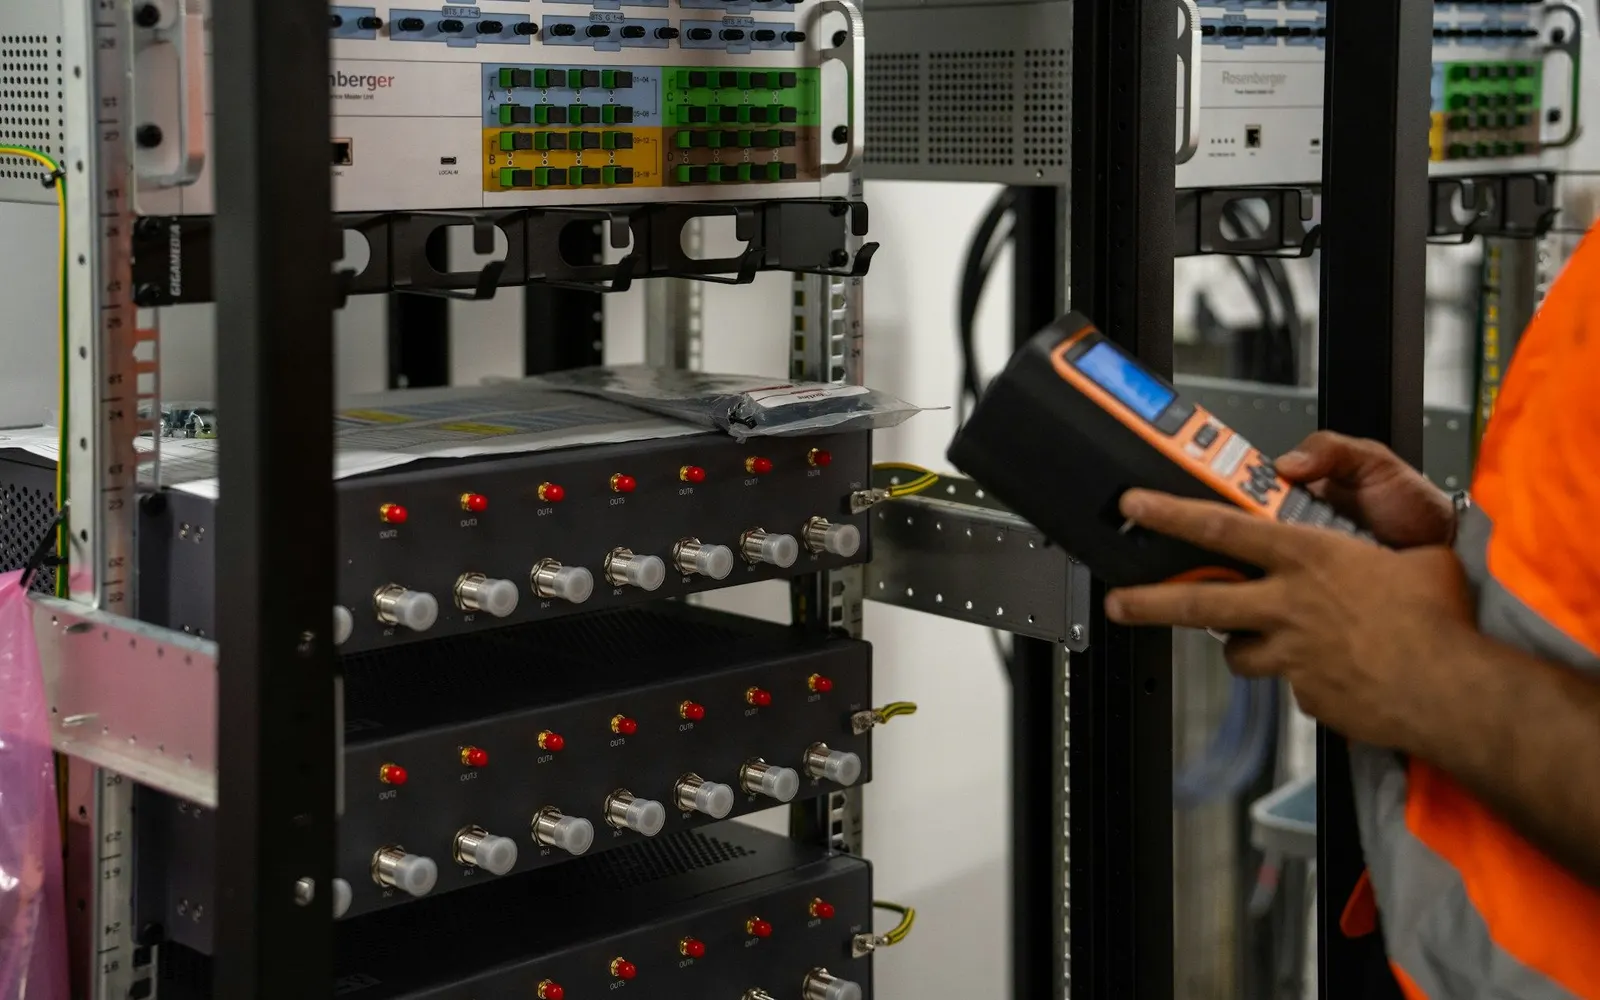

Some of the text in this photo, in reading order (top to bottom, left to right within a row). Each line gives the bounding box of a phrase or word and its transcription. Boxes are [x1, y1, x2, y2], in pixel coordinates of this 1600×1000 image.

[487, 90, 496, 101] A
[488, 154, 496, 164] B
[678, 487, 694, 496] OUT6
[609, 497, 625, 506] OUT5
[536, 508, 553, 517] OUT4
[460, 518, 477, 528] OUT3
[610, 738, 625, 748] OUT5
[536, 756, 553, 764] OUT4
[106, 774, 123, 787] 20
[460, 772, 478, 782] OUT3
[609, 980, 625, 991] OUT5
